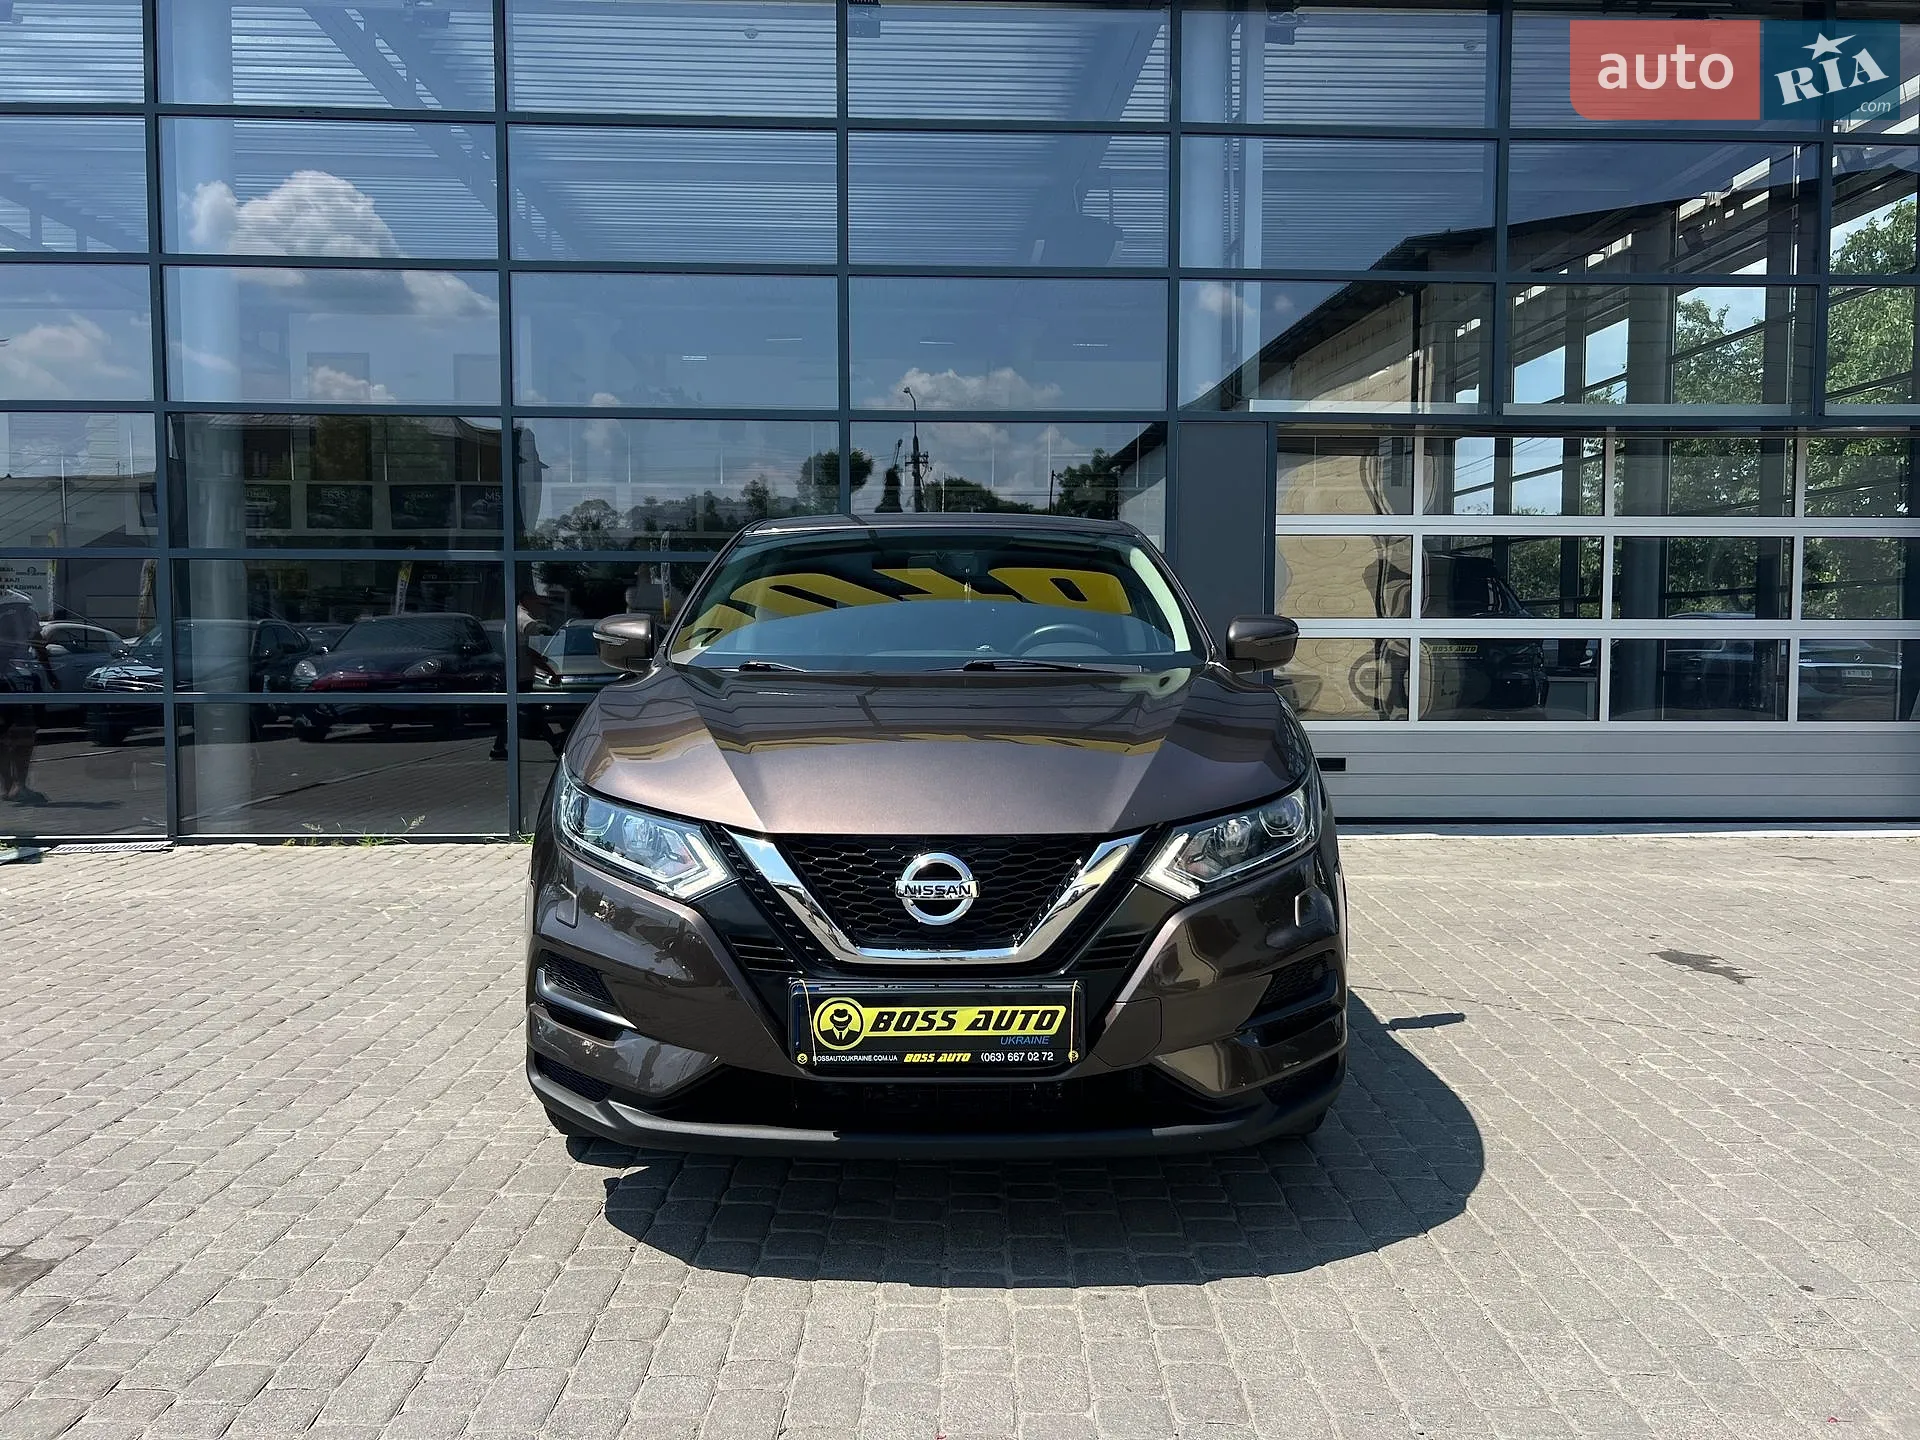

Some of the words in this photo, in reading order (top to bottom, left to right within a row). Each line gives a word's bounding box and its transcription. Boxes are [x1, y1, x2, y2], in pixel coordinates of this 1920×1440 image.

[904, 884, 971, 896] NISSAN
[869, 1010, 959, 1032] BOSS
[965, 1009, 1062, 1031] AUTO
[1000, 1035, 1050, 1046] UKRAINE
[903, 1053, 936, 1063] BOSS
[937, 1053, 971, 1063] AUTO
[980, 1052, 1005, 1062] (063)
[1007, 1052, 1026, 1062] 667
[1027, 1052, 1040, 1062] 02
[1041, 1052, 1054, 1061] 72
